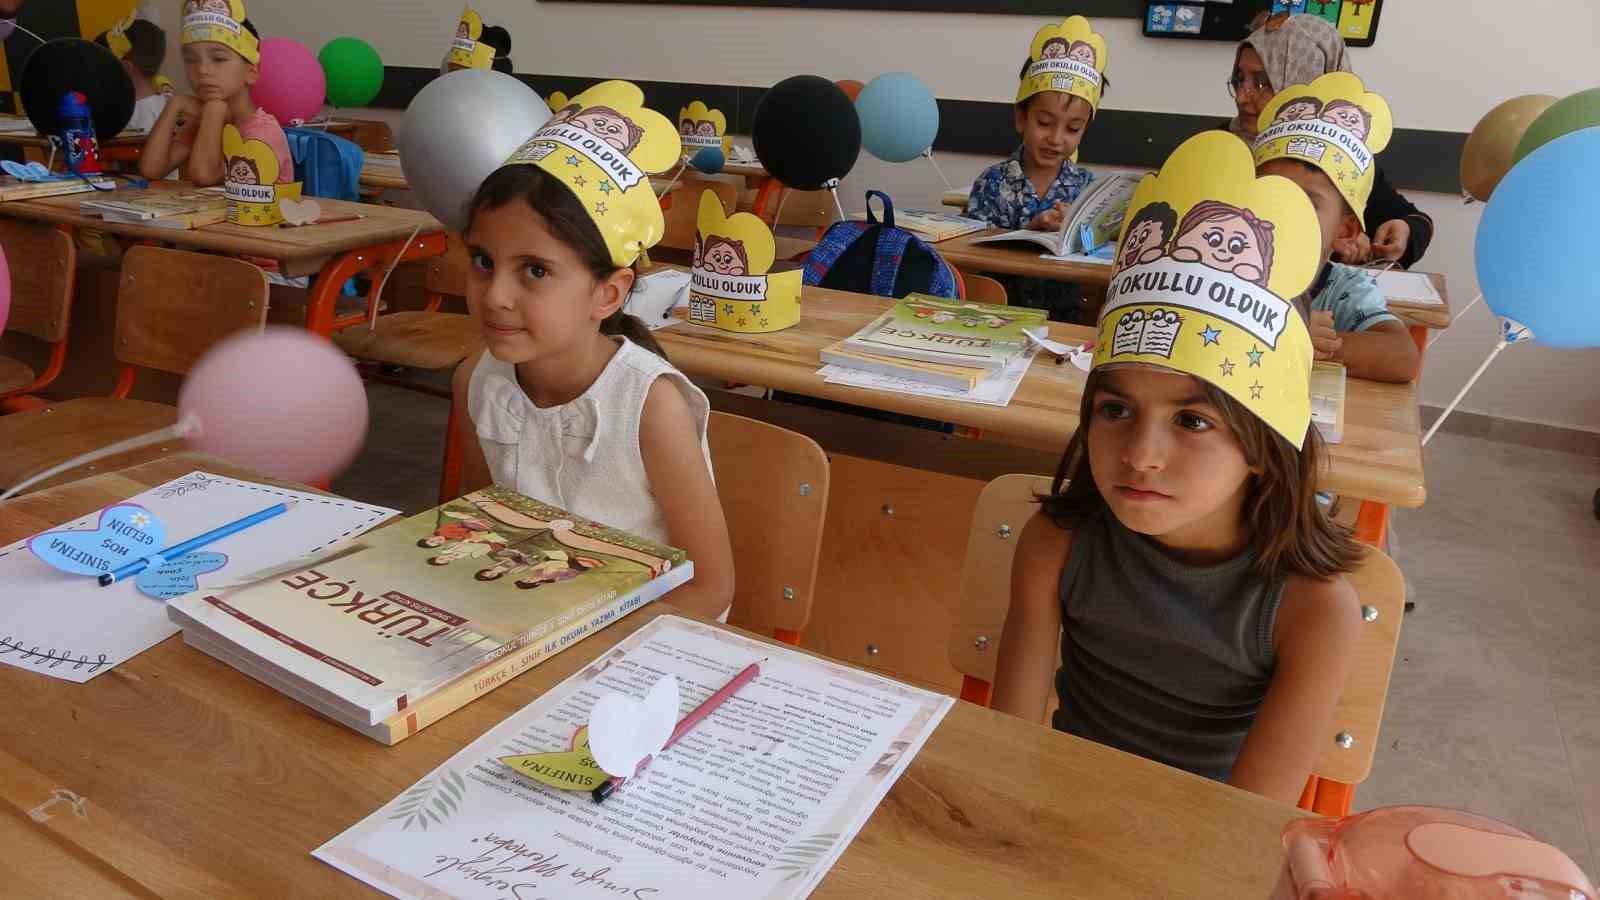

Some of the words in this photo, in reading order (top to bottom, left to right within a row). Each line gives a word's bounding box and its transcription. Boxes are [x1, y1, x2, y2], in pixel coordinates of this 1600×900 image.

[582, 139, 633, 181] OLDUK
[1287, 123, 1336, 138] OKULLU
[1339, 134, 1368, 167] OLDUK
[241, 188, 271, 199] OLDUK
[721, 281, 761, 295] OLDUK
[1119, 271, 1203, 297] OKULLU
[1208, 281, 1279, 332] OLDUK
[101, 538, 130, 556] HOŞ
[107, 518, 154, 545] GELDİN
[50, 537, 111, 572] SINIFINA
[281, 570, 450, 647] TÜRKÇE
[473, 668, 508, 693] TÜRKÇE
[543, 641, 557, 656] İLK
[559, 626, 589, 646] OKUMA
[591, 609, 616, 629] YAZMA
[618, 594, 642, 613] KİTABI
[521, 760, 593, 786] SINIFINA
